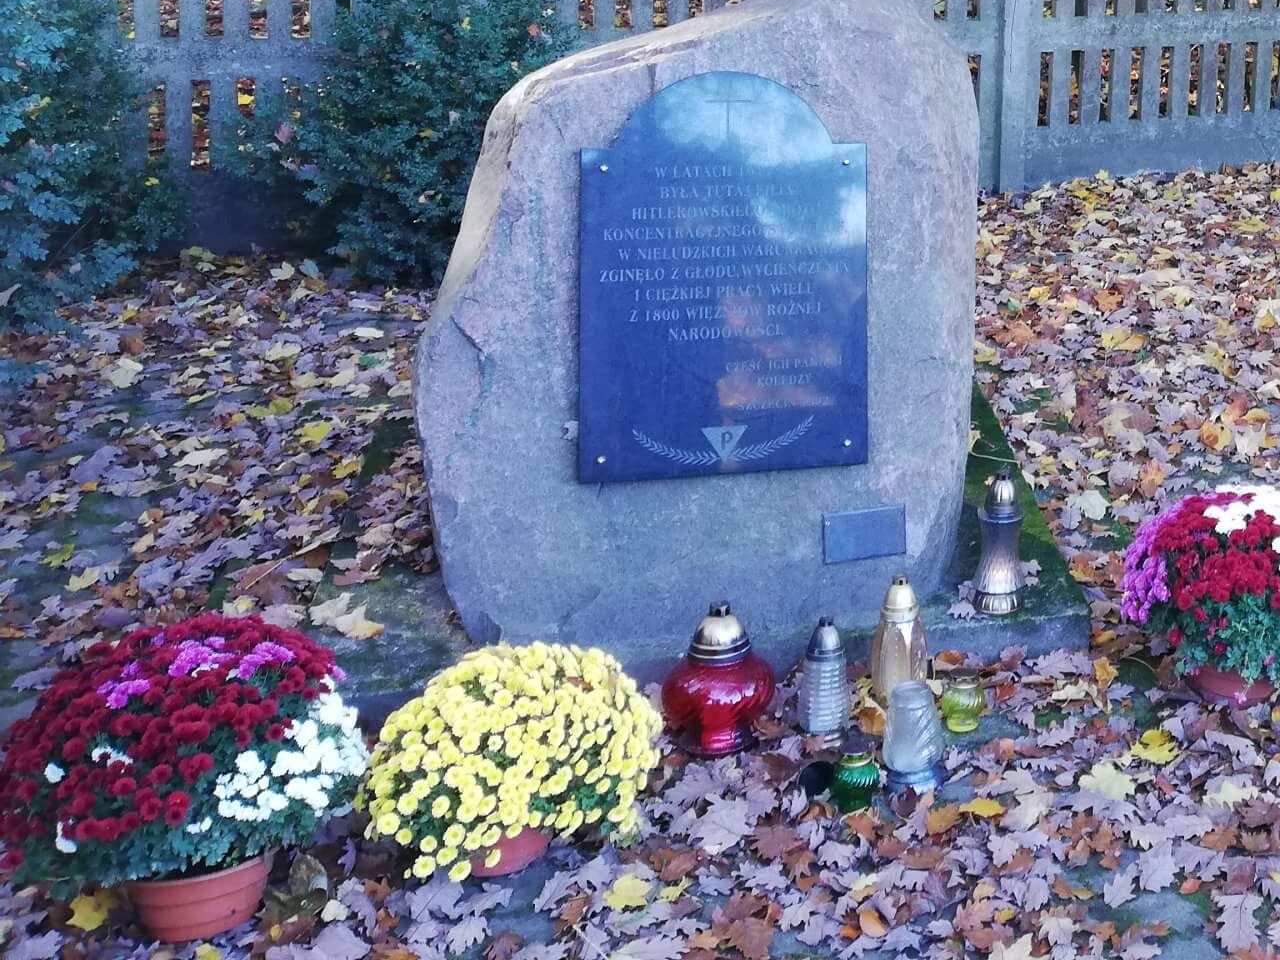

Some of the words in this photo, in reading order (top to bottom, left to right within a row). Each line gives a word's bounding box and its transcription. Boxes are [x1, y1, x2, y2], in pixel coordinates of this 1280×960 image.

[655, 166, 668, 179] W
[673, 165, 732, 178] LATACH
[603, 223, 760, 242] KONCENTRACYJNEGO
[618, 248, 632, 261] W
[637, 244, 737, 260] NIELUDZKICH
[671, 266, 680, 279] Z
[716, 284, 763, 299] PRACY
[771, 282, 813, 296] WIELU
[628, 309, 638, 322] Z
[645, 308, 680, 322] 1800
